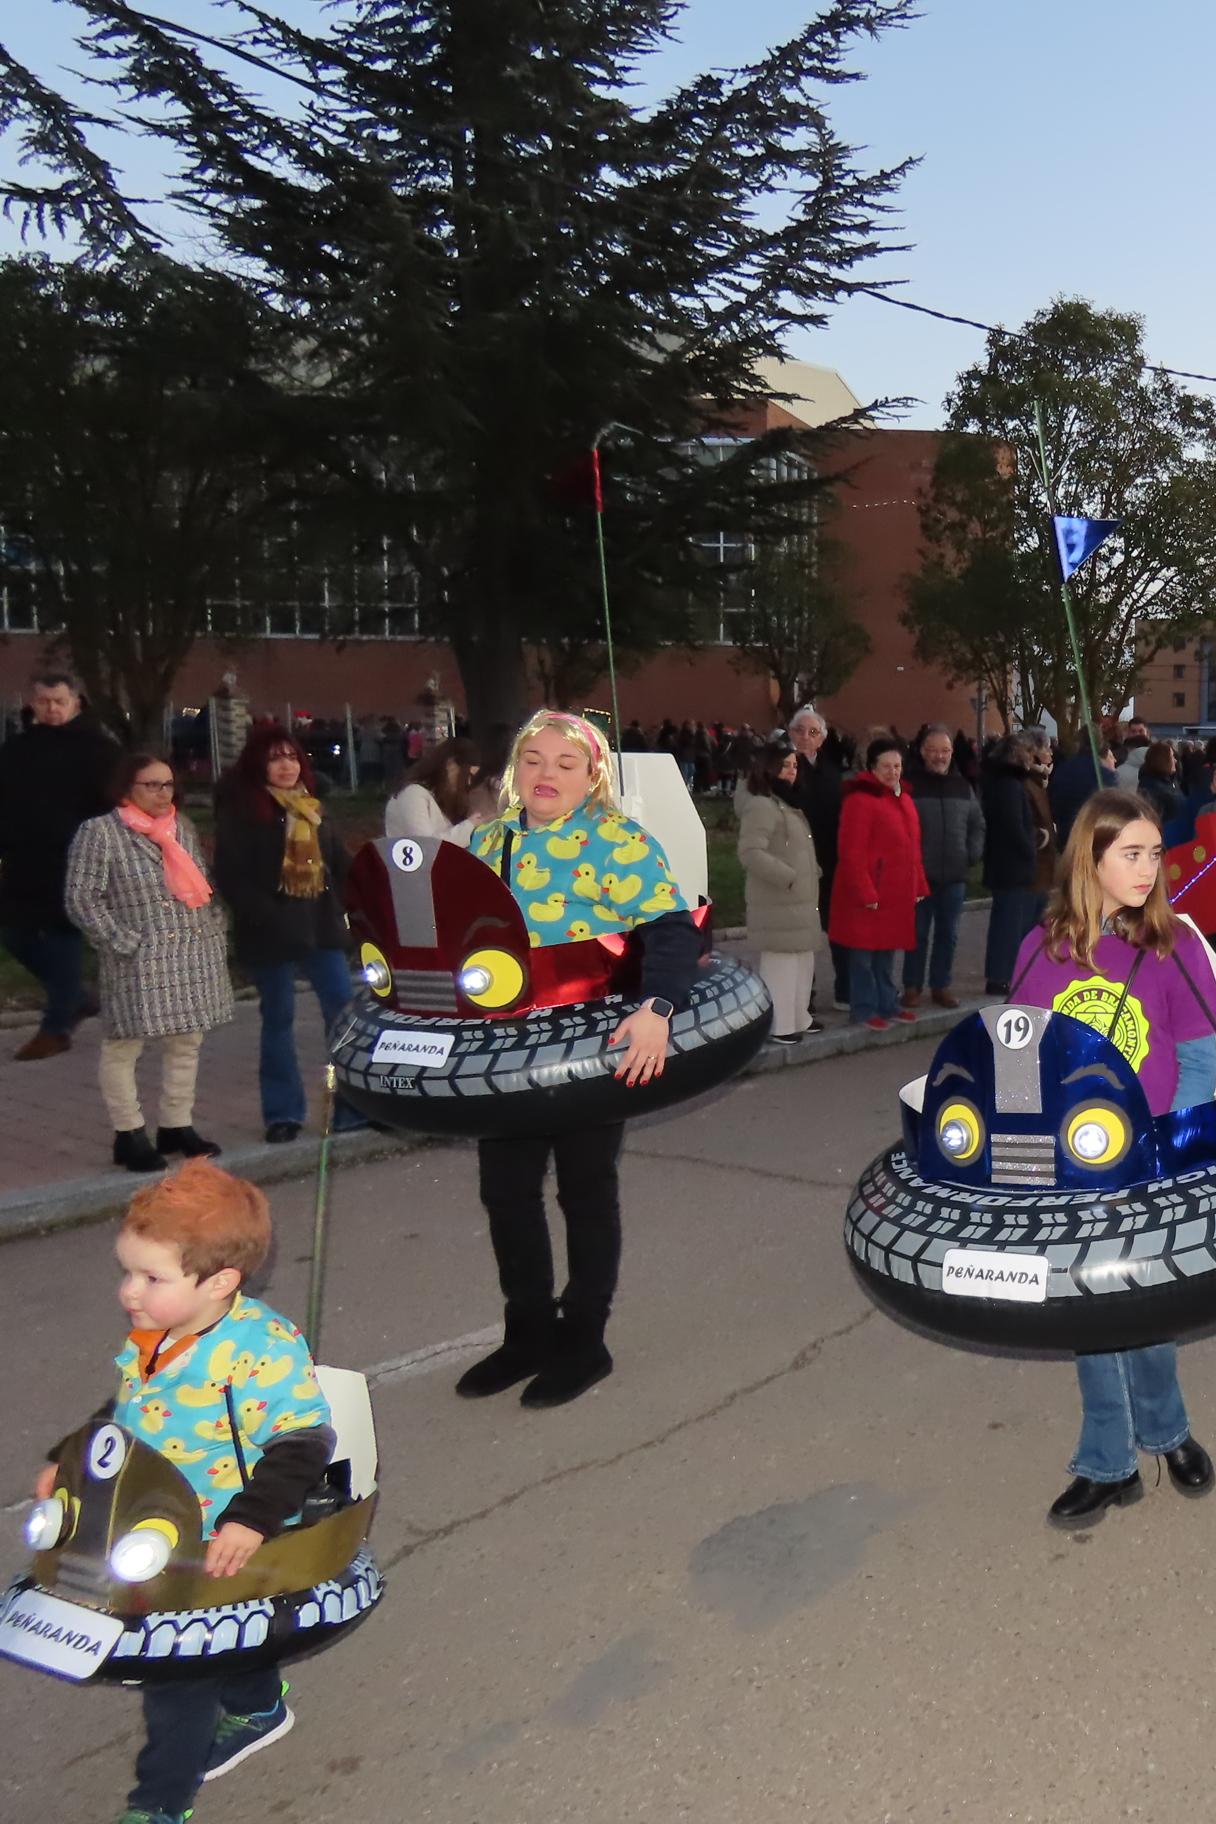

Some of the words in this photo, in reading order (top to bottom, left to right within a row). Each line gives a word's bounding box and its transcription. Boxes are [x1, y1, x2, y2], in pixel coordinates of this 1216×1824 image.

[402, 846, 413, 866] 8
[1083, 990, 1098, 1001] DE
[1004, 1015, 1030, 1044] 19
[378, 1041, 445, 1056] PEÑARANDA
[380, 1075, 415, 1089] INTEX
[891, 1151, 1131, 1207] PERFORMANCE
[946, 1264, 1040, 1285] PEÑARANDA
[97, 1436, 117, 1468] 2
[5, 1611, 103, 1656] PEÑARANDA
